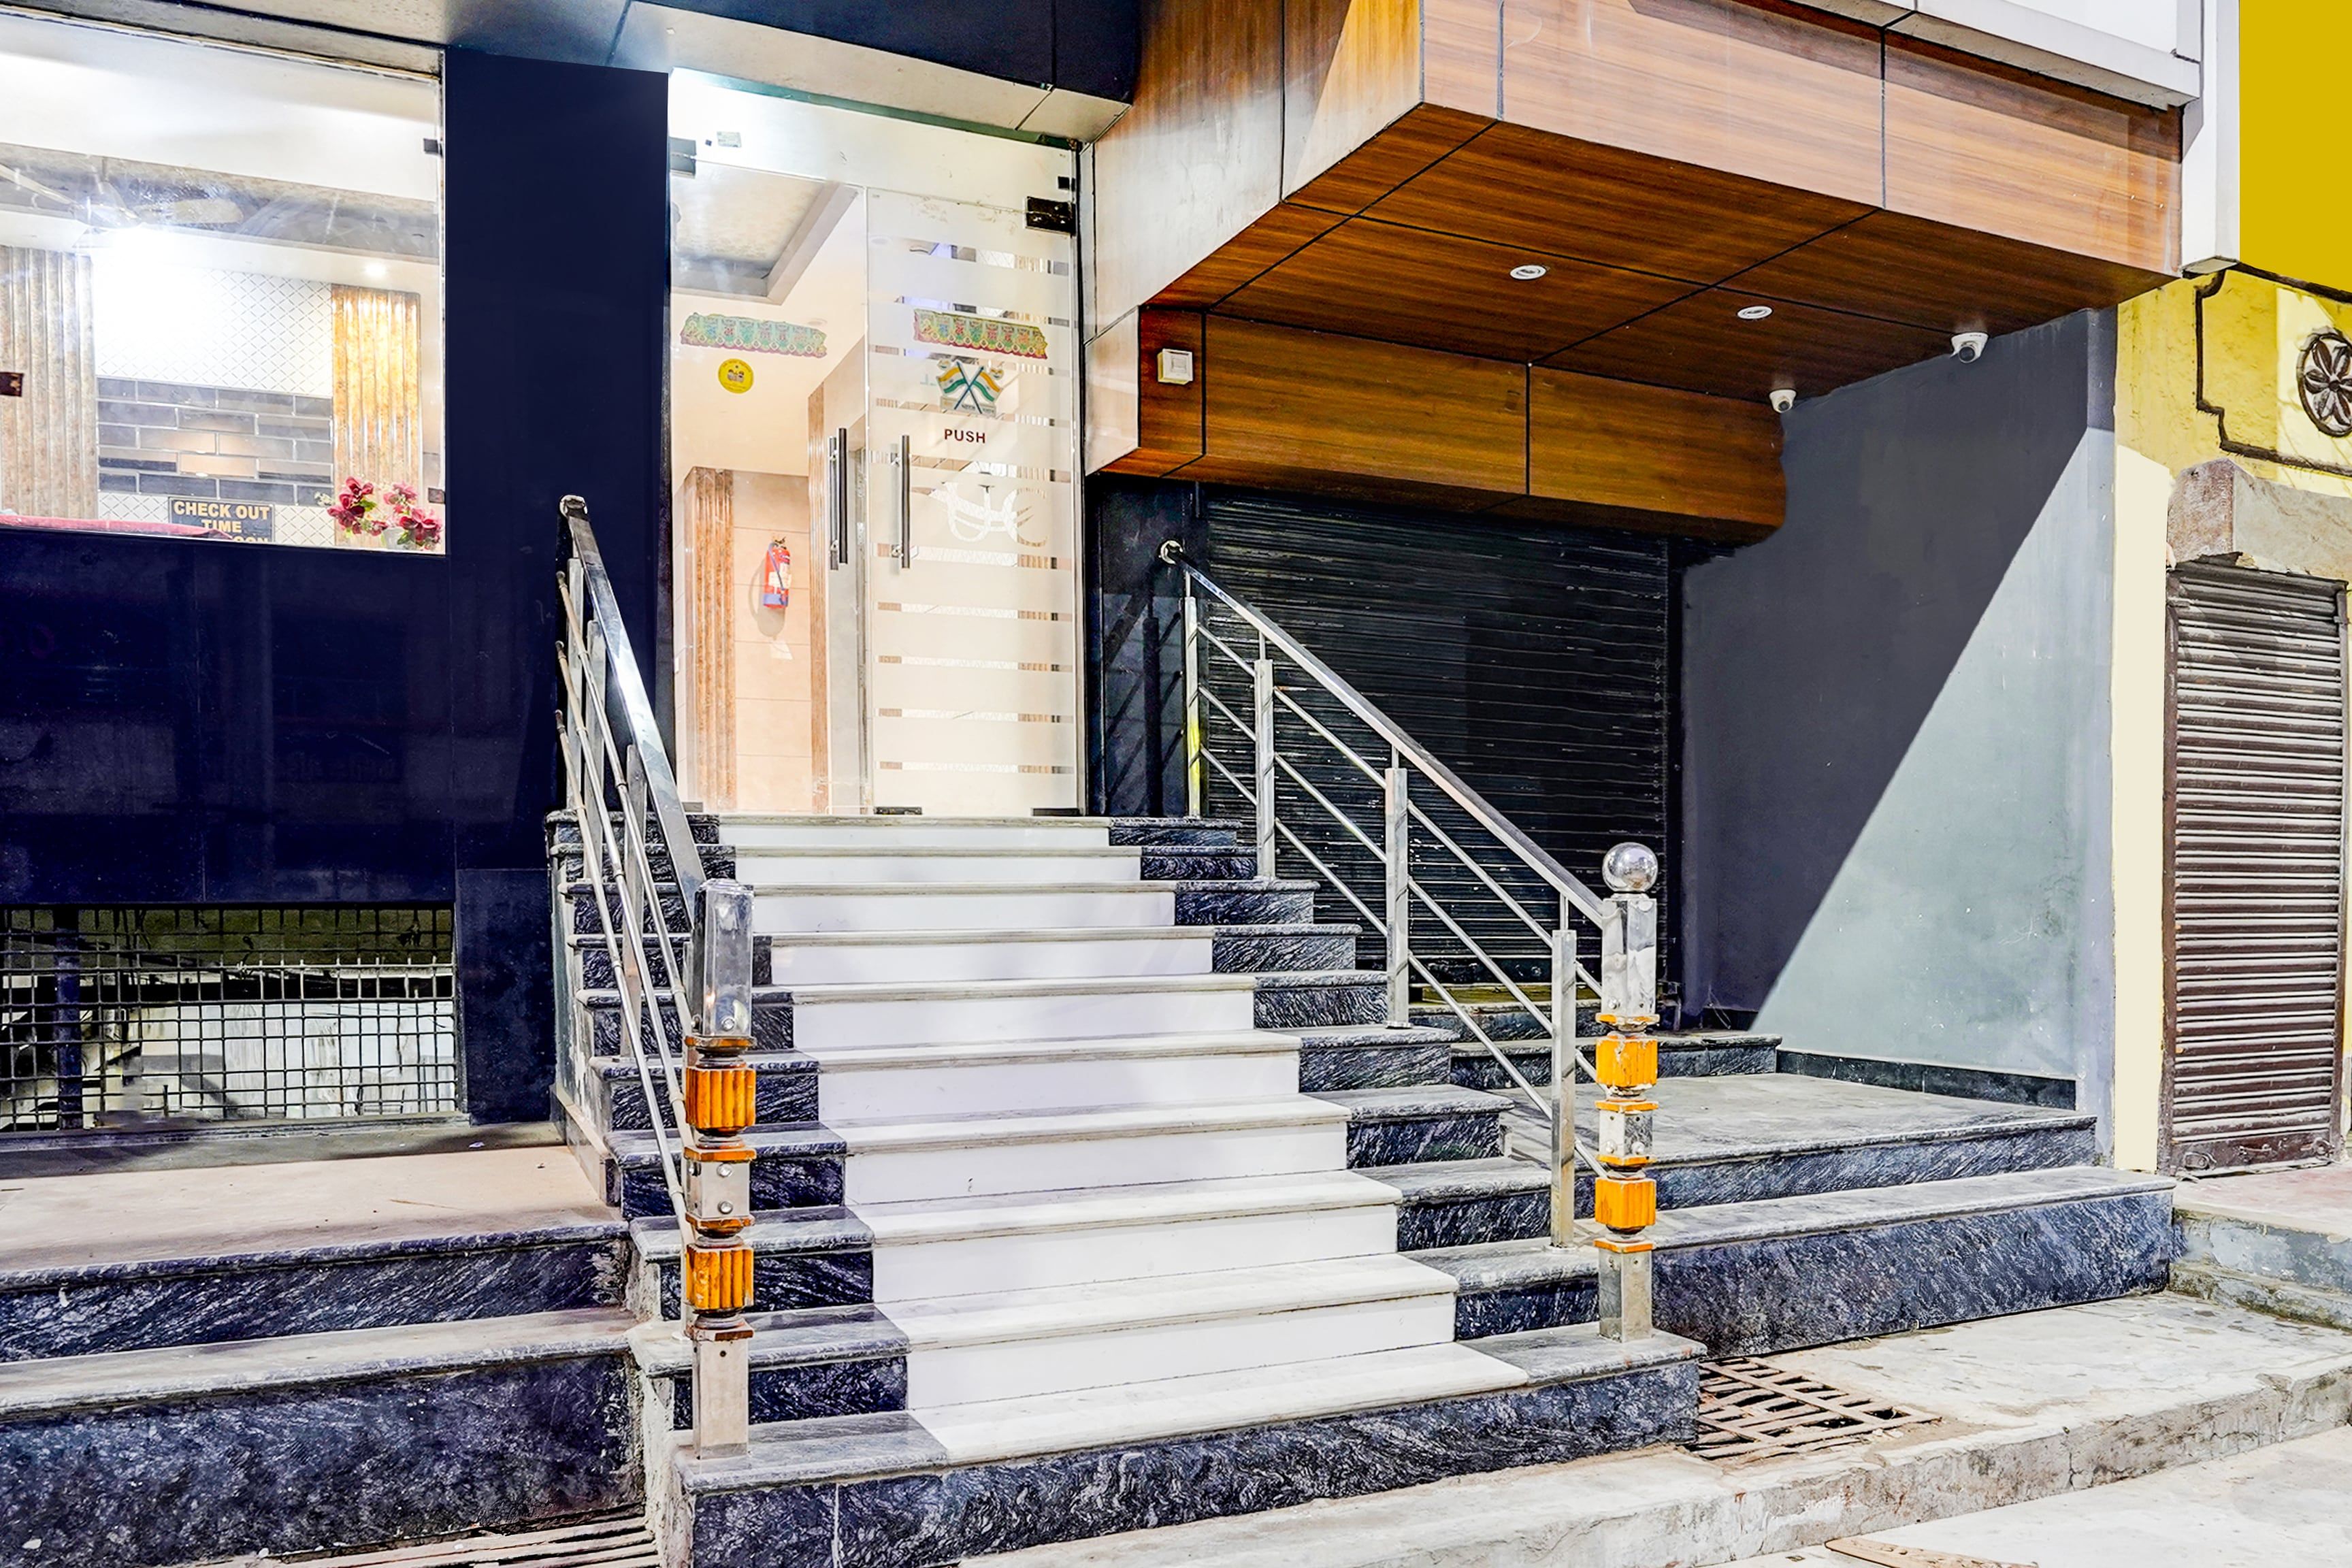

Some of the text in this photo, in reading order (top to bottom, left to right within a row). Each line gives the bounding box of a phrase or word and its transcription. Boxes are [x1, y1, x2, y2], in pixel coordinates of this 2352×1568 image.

[944, 429, 985, 444] PUSH
[174, 501, 270, 520] CHECK OUT
[201, 519, 242, 533] TIME
